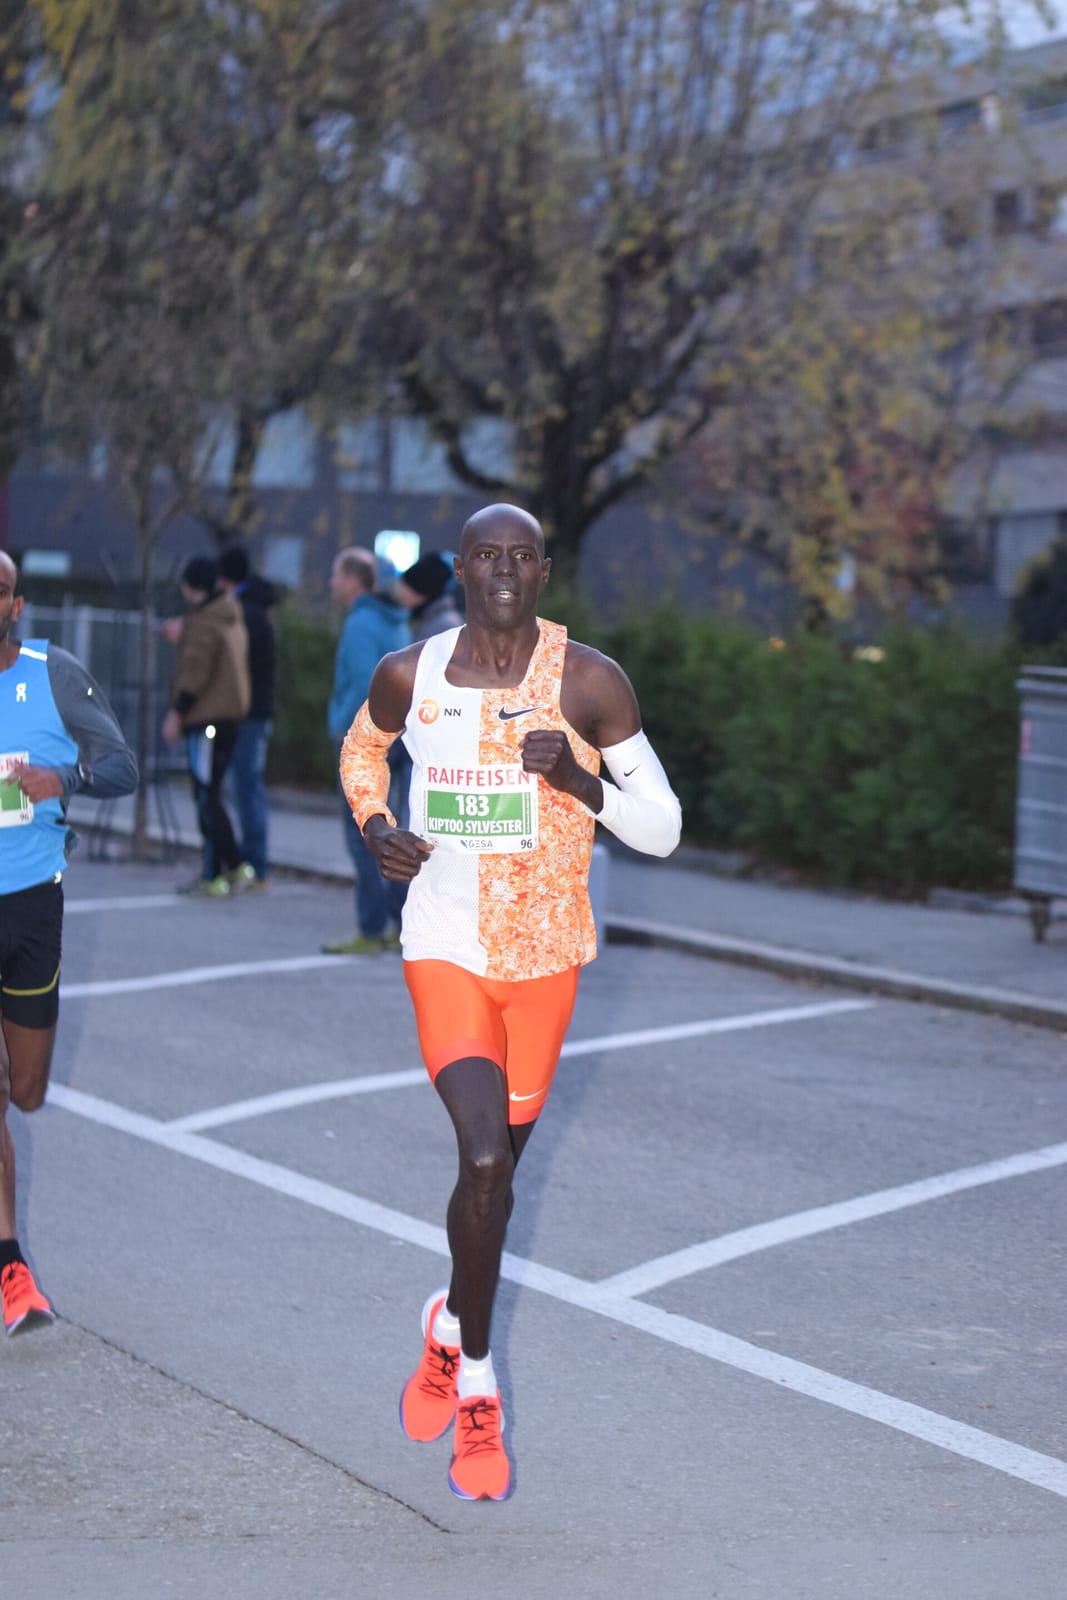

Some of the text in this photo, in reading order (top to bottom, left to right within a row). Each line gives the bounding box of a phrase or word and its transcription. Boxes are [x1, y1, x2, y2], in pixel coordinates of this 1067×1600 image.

[444, 708, 461, 717] NN
[427, 767, 530, 787] RAIFFEISEN
[455, 794, 490, 816] 183
[428, 817, 522, 834] KIPTOO SYLVESTER
[520, 839, 533, 849] 96
